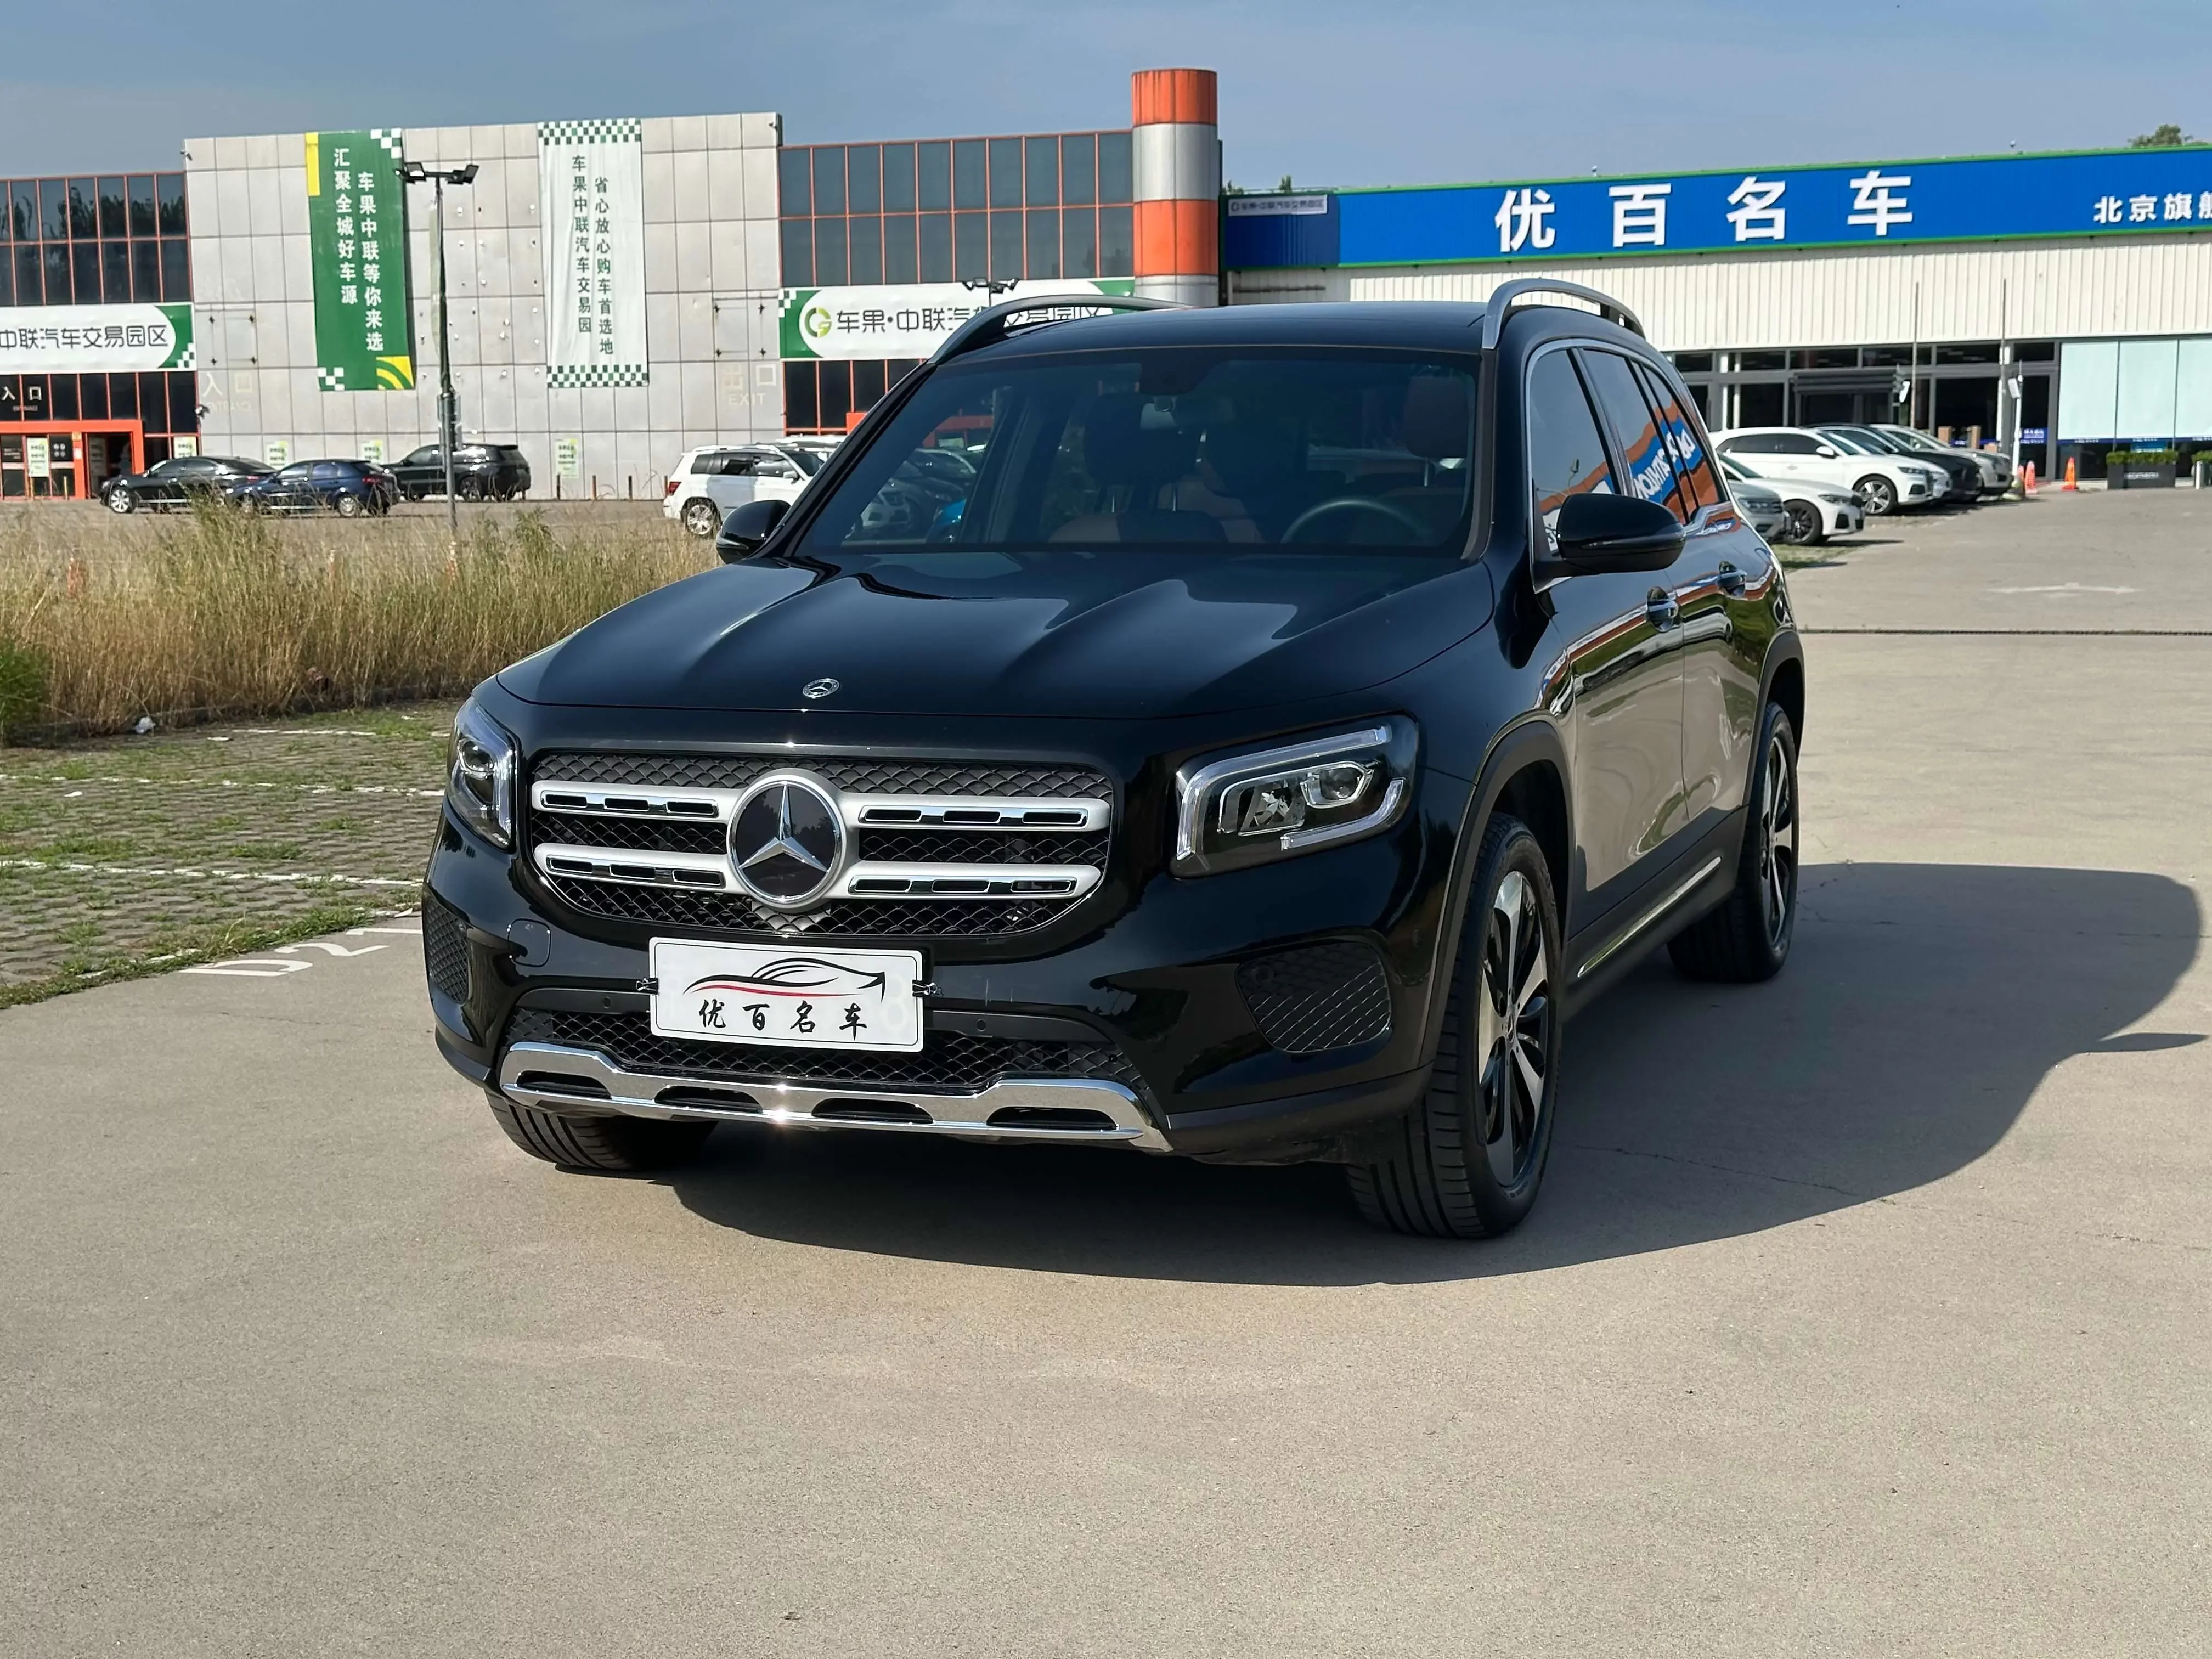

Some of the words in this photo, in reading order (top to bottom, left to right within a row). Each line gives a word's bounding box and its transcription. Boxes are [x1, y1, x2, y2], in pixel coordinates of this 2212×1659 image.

[334, 148, 358, 305] 汇聚全城好车源
[572, 155, 591, 332] 车果中联汽车交易园
[1494, 170, 1913, 252] 优百名车
[358, 171, 384, 352] 车果中联等你来选
[595, 176, 614, 355] 省心放心购车首选地
[0, 325, 168, 349] 中联汽车交易园区
[2, 386, 43, 401] 入口
[728, 392, 766, 406] EXIT
[698, 999, 867, 1041] 优百名车
